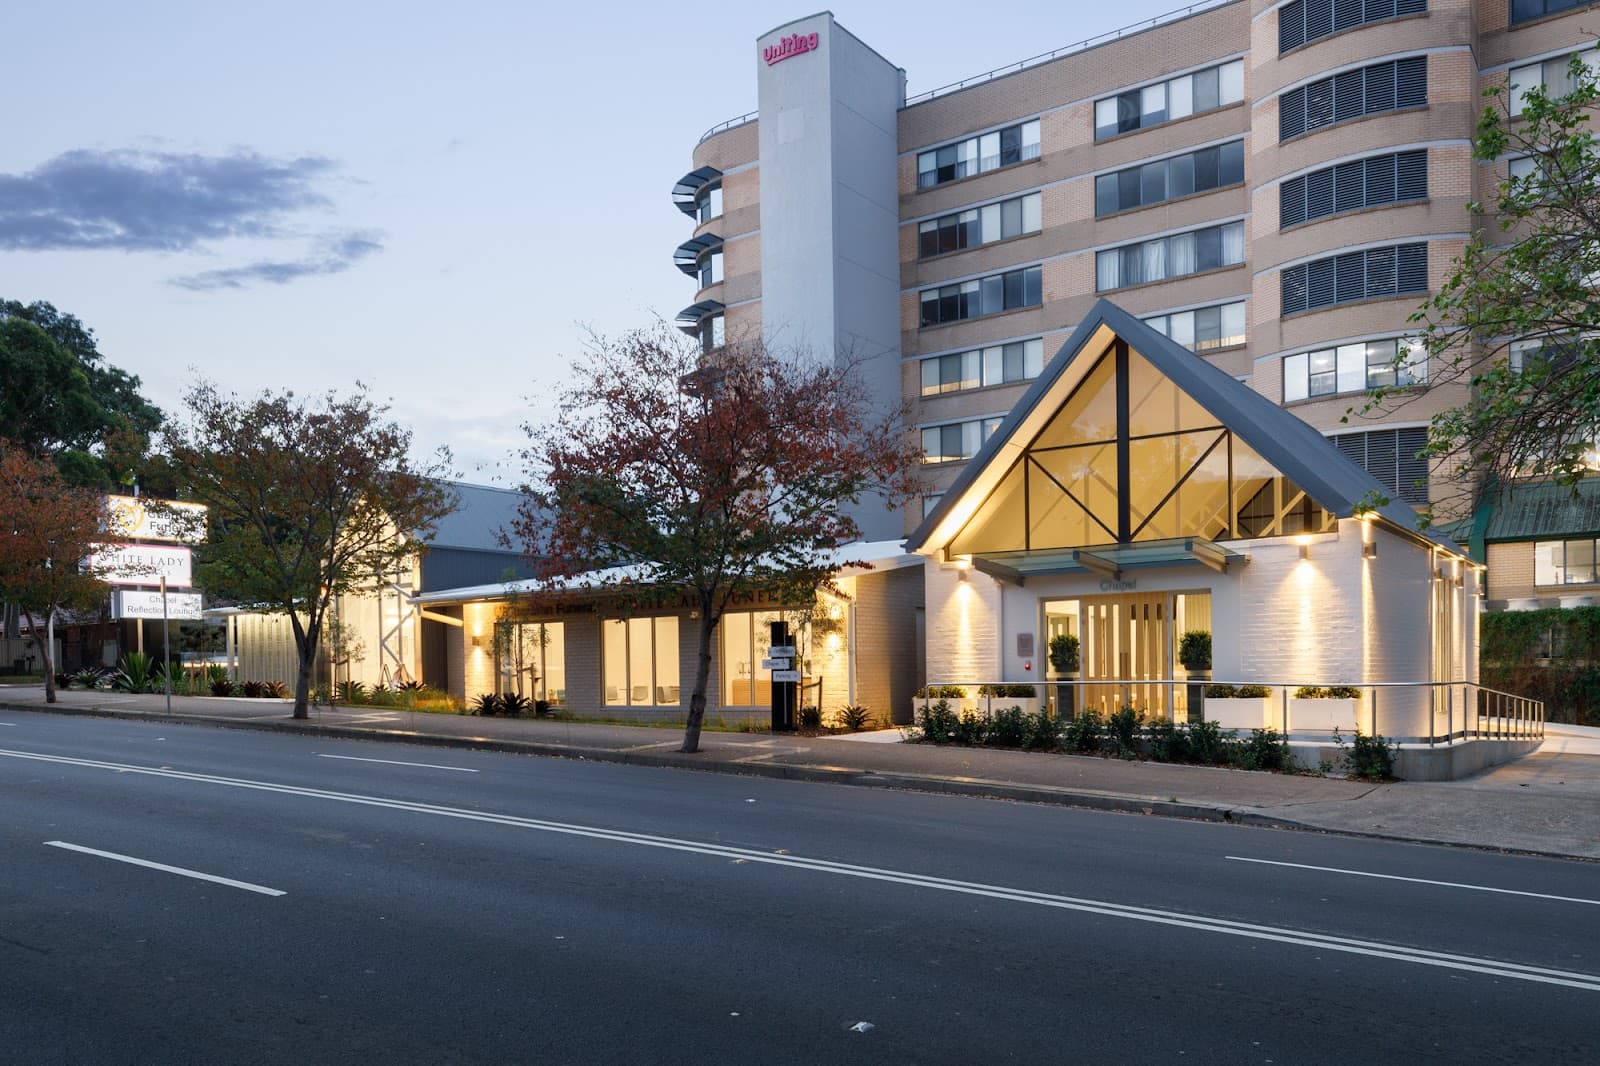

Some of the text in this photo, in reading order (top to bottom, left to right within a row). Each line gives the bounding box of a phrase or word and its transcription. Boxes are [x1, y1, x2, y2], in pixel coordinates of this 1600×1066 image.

[763, 32, 819, 65] Uniting
[150, 555, 184, 567] LADY
[1100, 578, 1137, 592] Chapel
